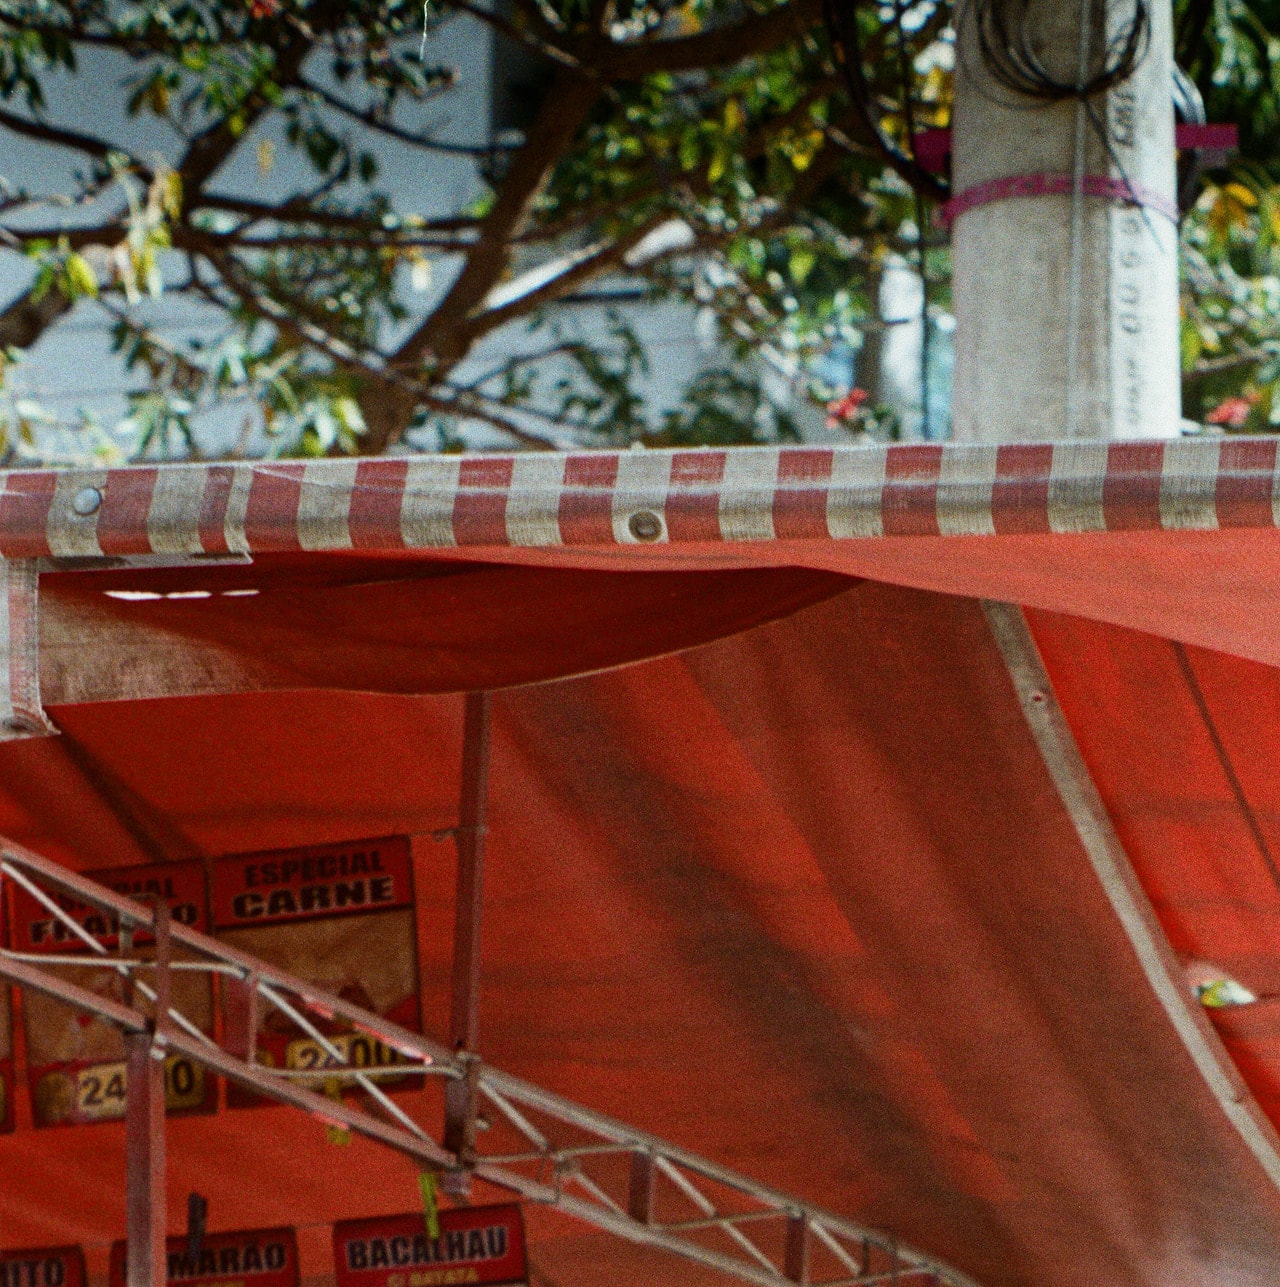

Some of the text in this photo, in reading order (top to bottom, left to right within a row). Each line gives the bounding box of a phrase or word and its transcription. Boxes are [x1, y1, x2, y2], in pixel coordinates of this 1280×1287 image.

[244, 851, 385, 888] ESPECIAL
[232, 875, 394, 918] CARNE
[31, 903, 197, 943] FRAO
[81, 1058, 195, 1106] 240
[347, 1226, 508, 1270] BACALHAU
